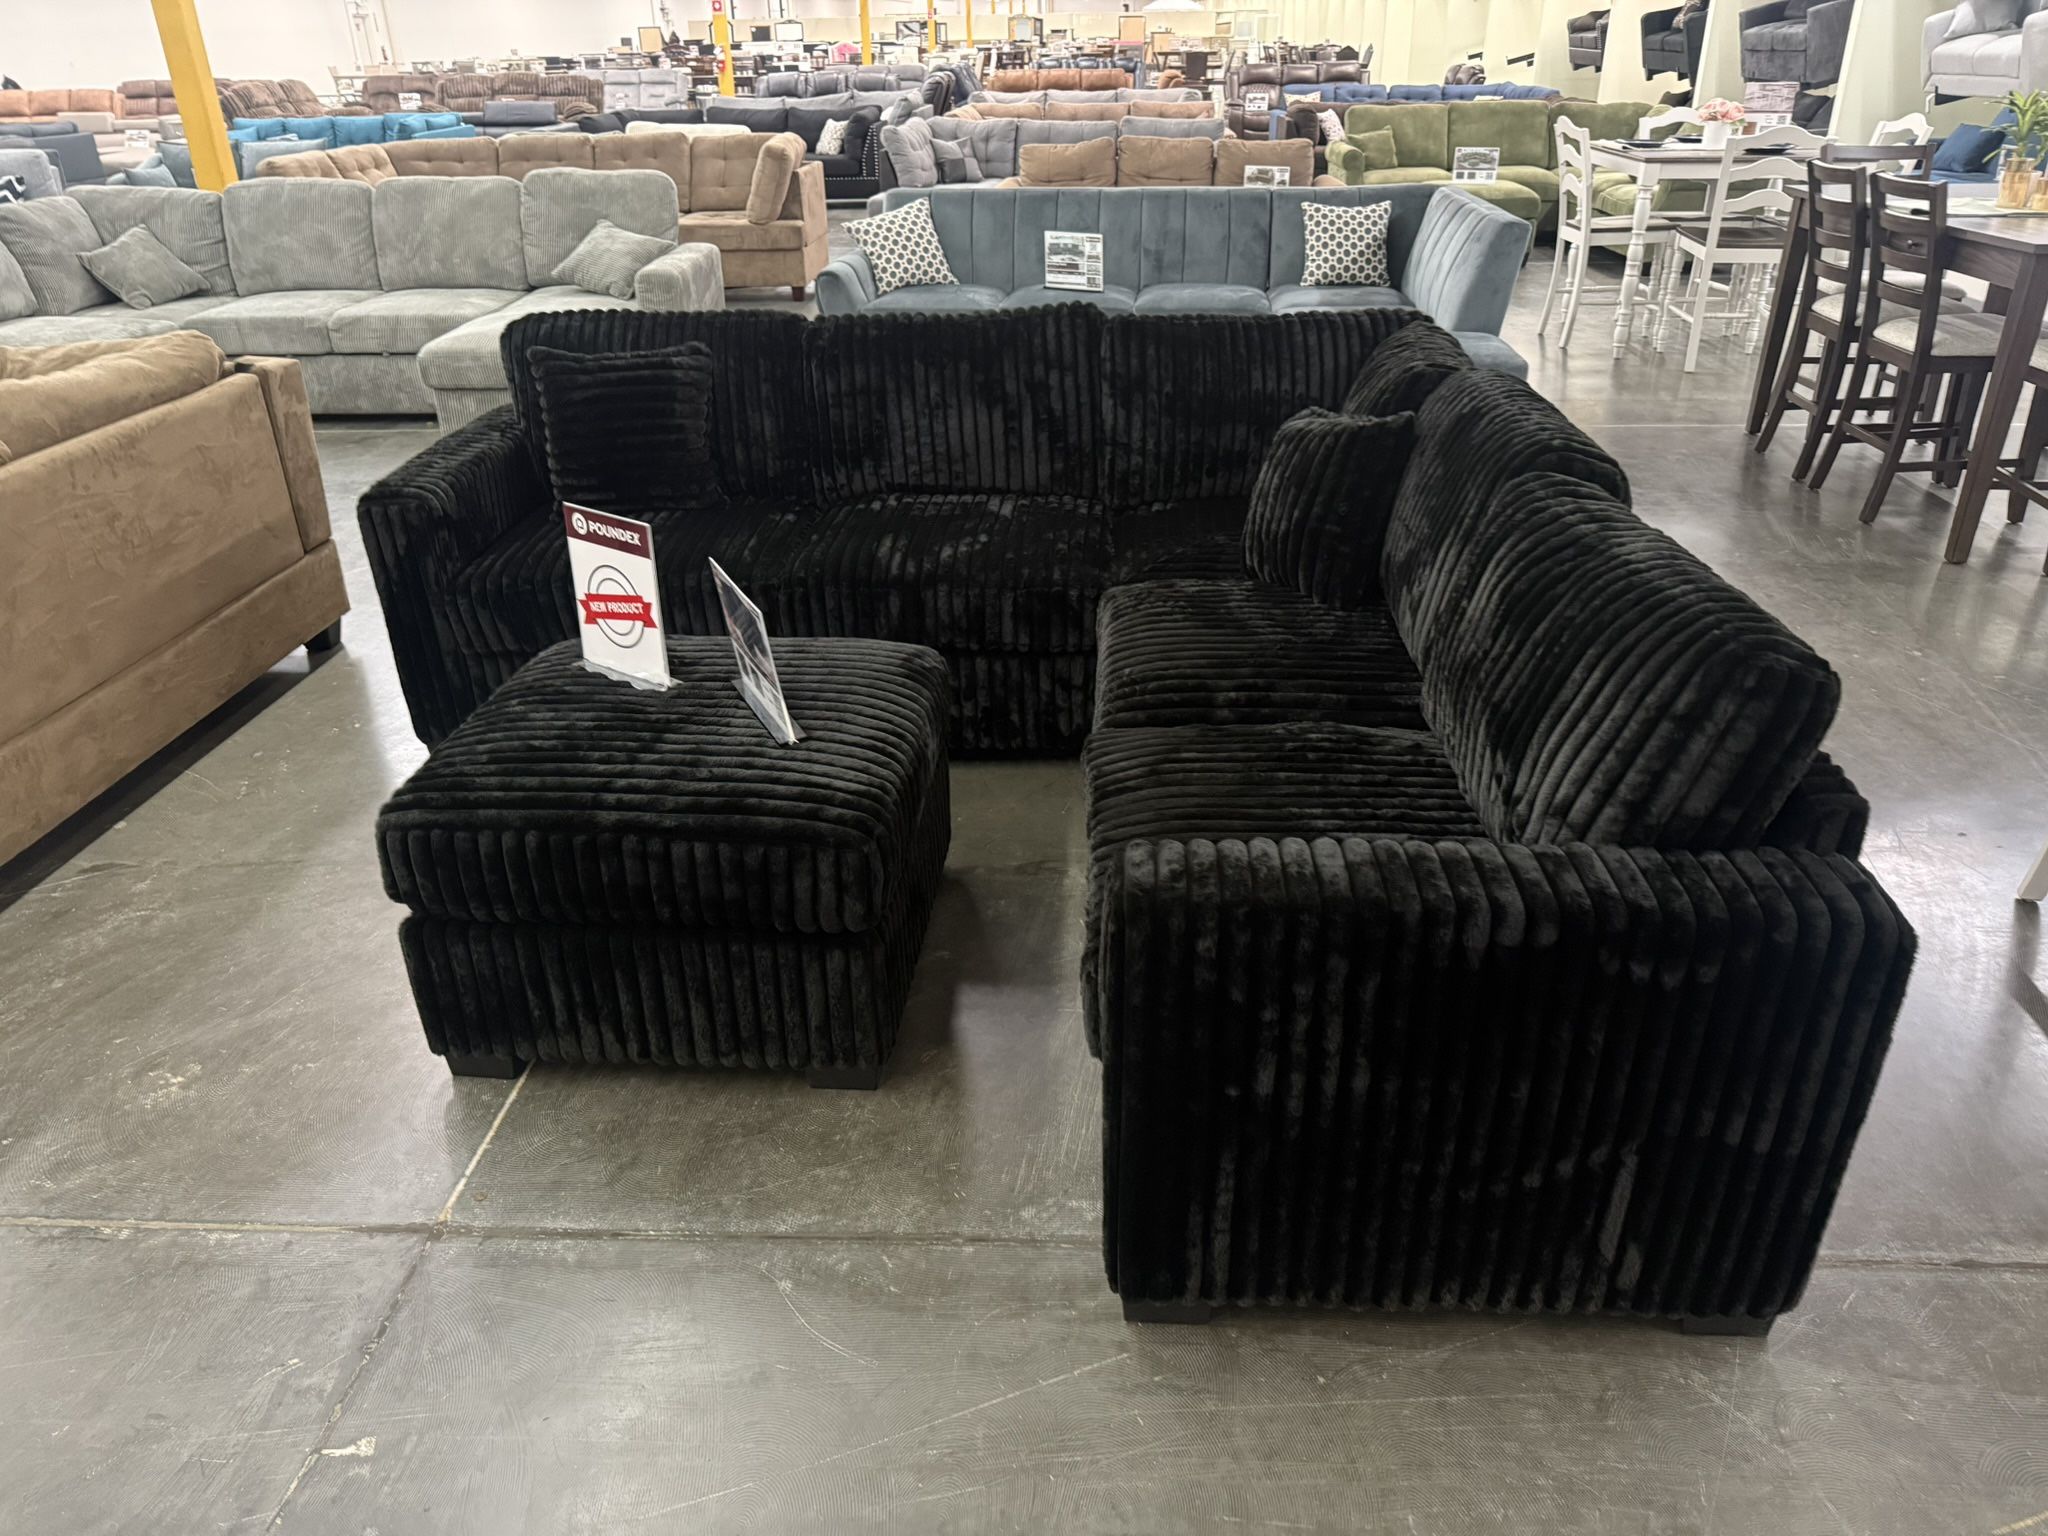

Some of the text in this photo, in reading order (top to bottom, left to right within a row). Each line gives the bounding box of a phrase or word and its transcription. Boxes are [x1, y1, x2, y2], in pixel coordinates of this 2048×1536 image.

[588, 520, 641, 546] POUNDEX
[589, 601, 643, 614] NEW PRODUCT
